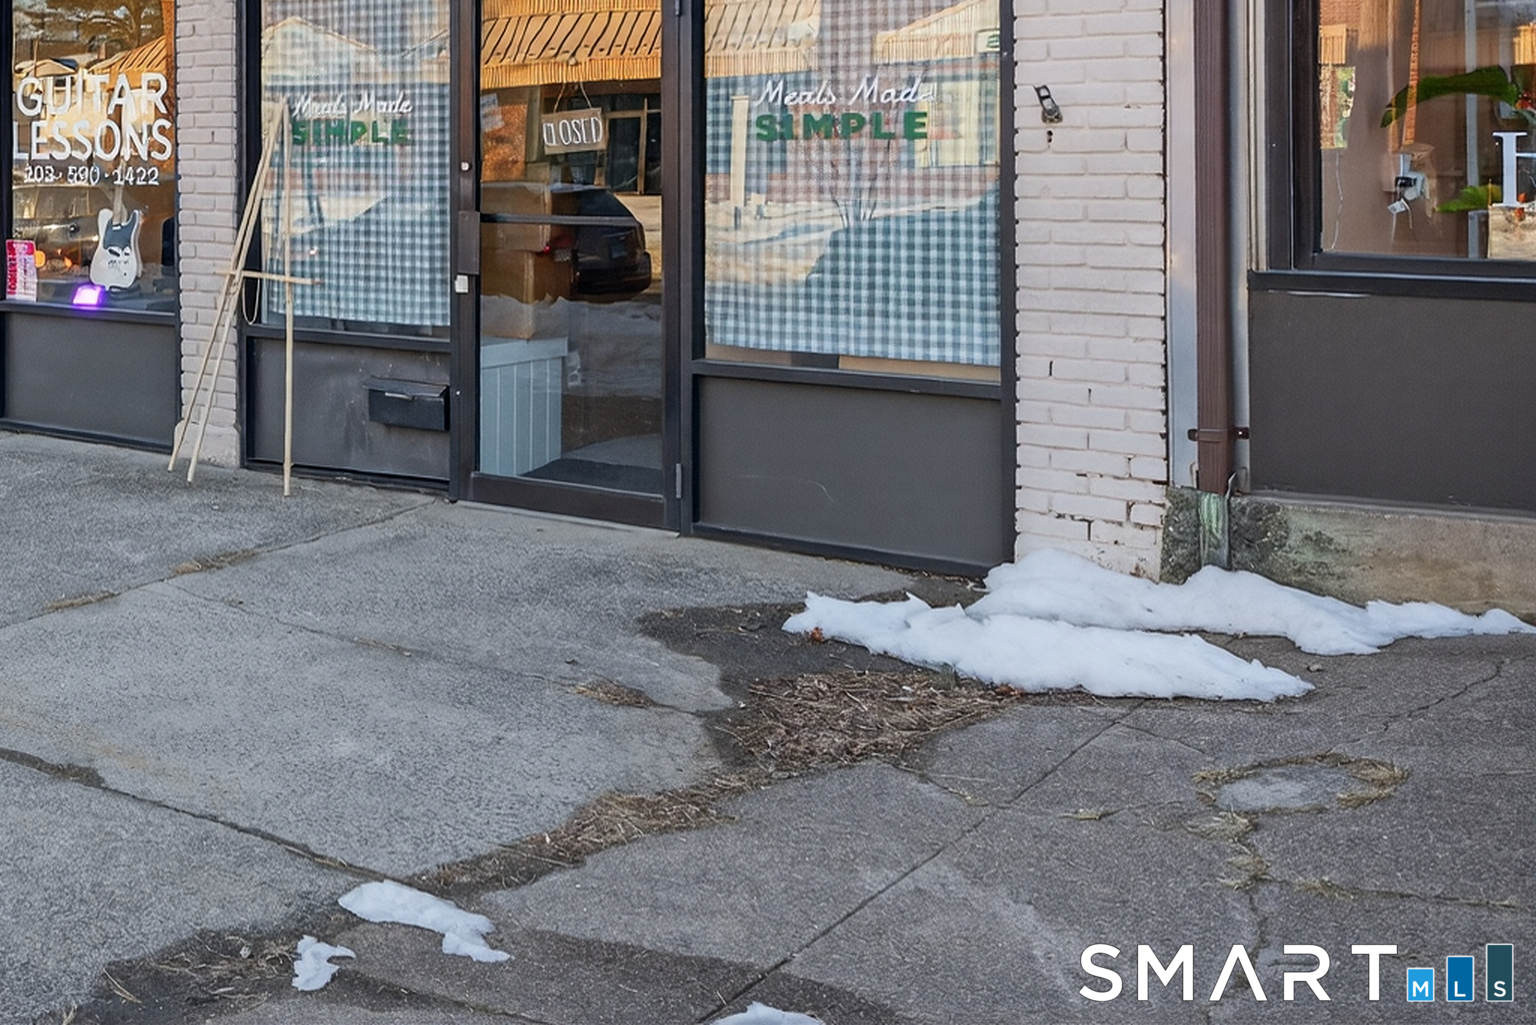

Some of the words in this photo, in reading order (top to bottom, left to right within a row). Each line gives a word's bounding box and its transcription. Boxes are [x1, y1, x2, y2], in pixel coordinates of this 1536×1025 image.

[16, 72, 168, 117] GUITAR
[756, 78, 836, 107] Meals
[13, 119, 172, 162] LESSONS
[292, 119, 414, 146] SIMPLE
[755, 111, 928, 142] SIMPLE
